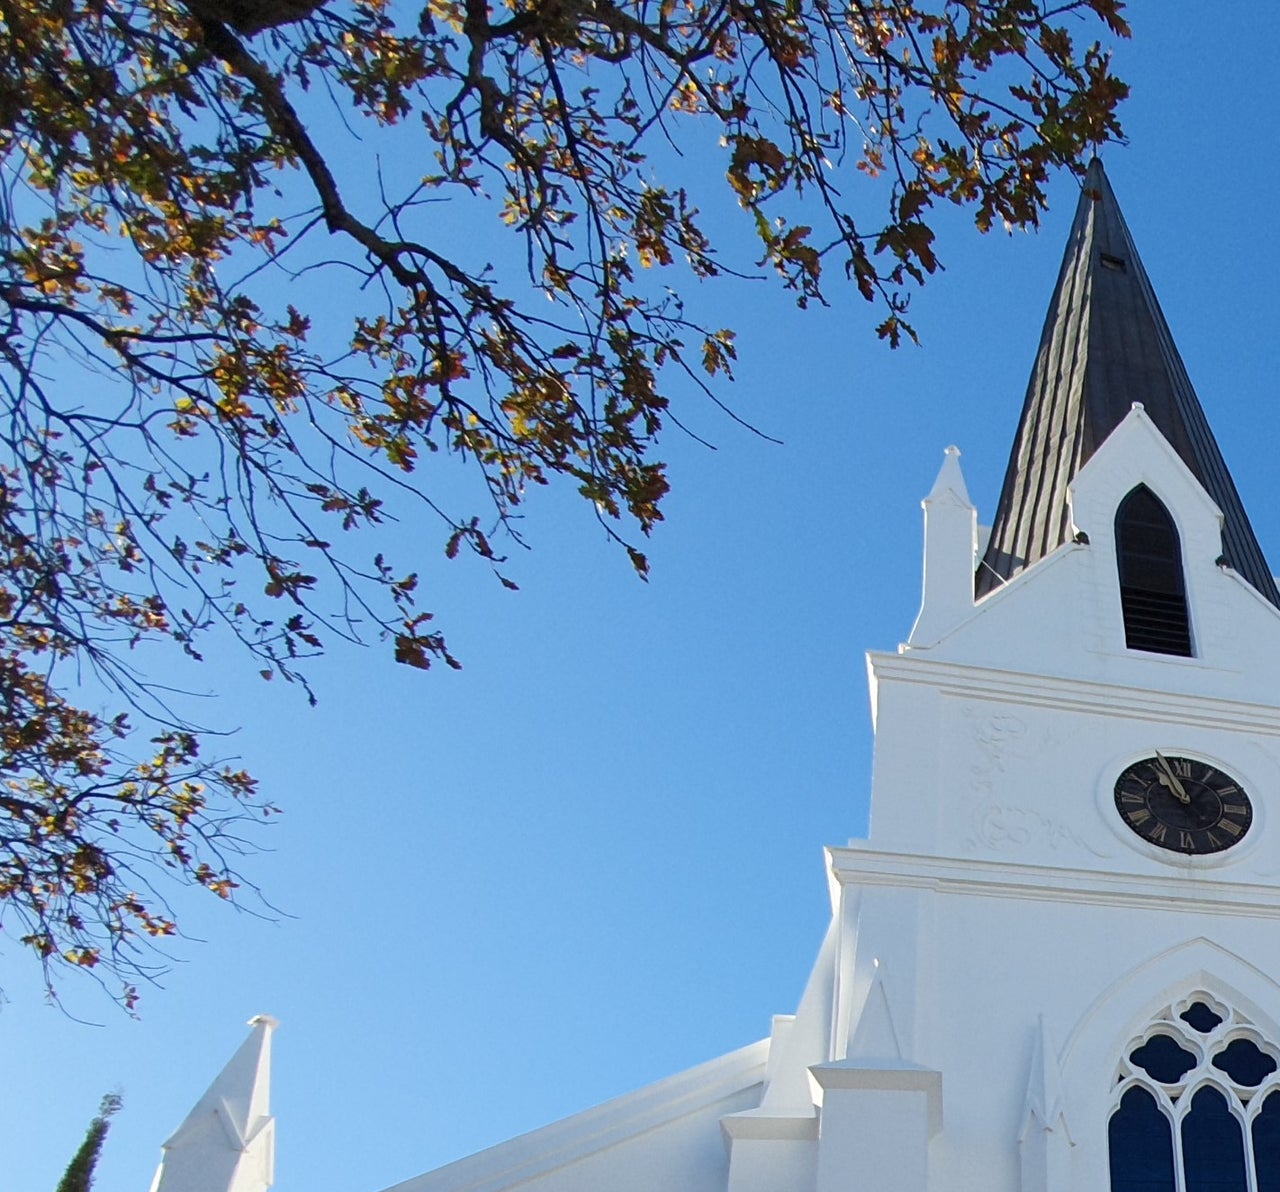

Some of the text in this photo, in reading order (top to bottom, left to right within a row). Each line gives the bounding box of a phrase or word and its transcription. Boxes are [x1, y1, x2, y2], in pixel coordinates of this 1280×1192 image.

[1174, 760, 1192, 778] XII
[1202, 769, 1214, 782] I
[1216, 785, 1238, 796] II
[1180, 831, 1195, 849] VI
[1207, 831, 1221, 847] V
